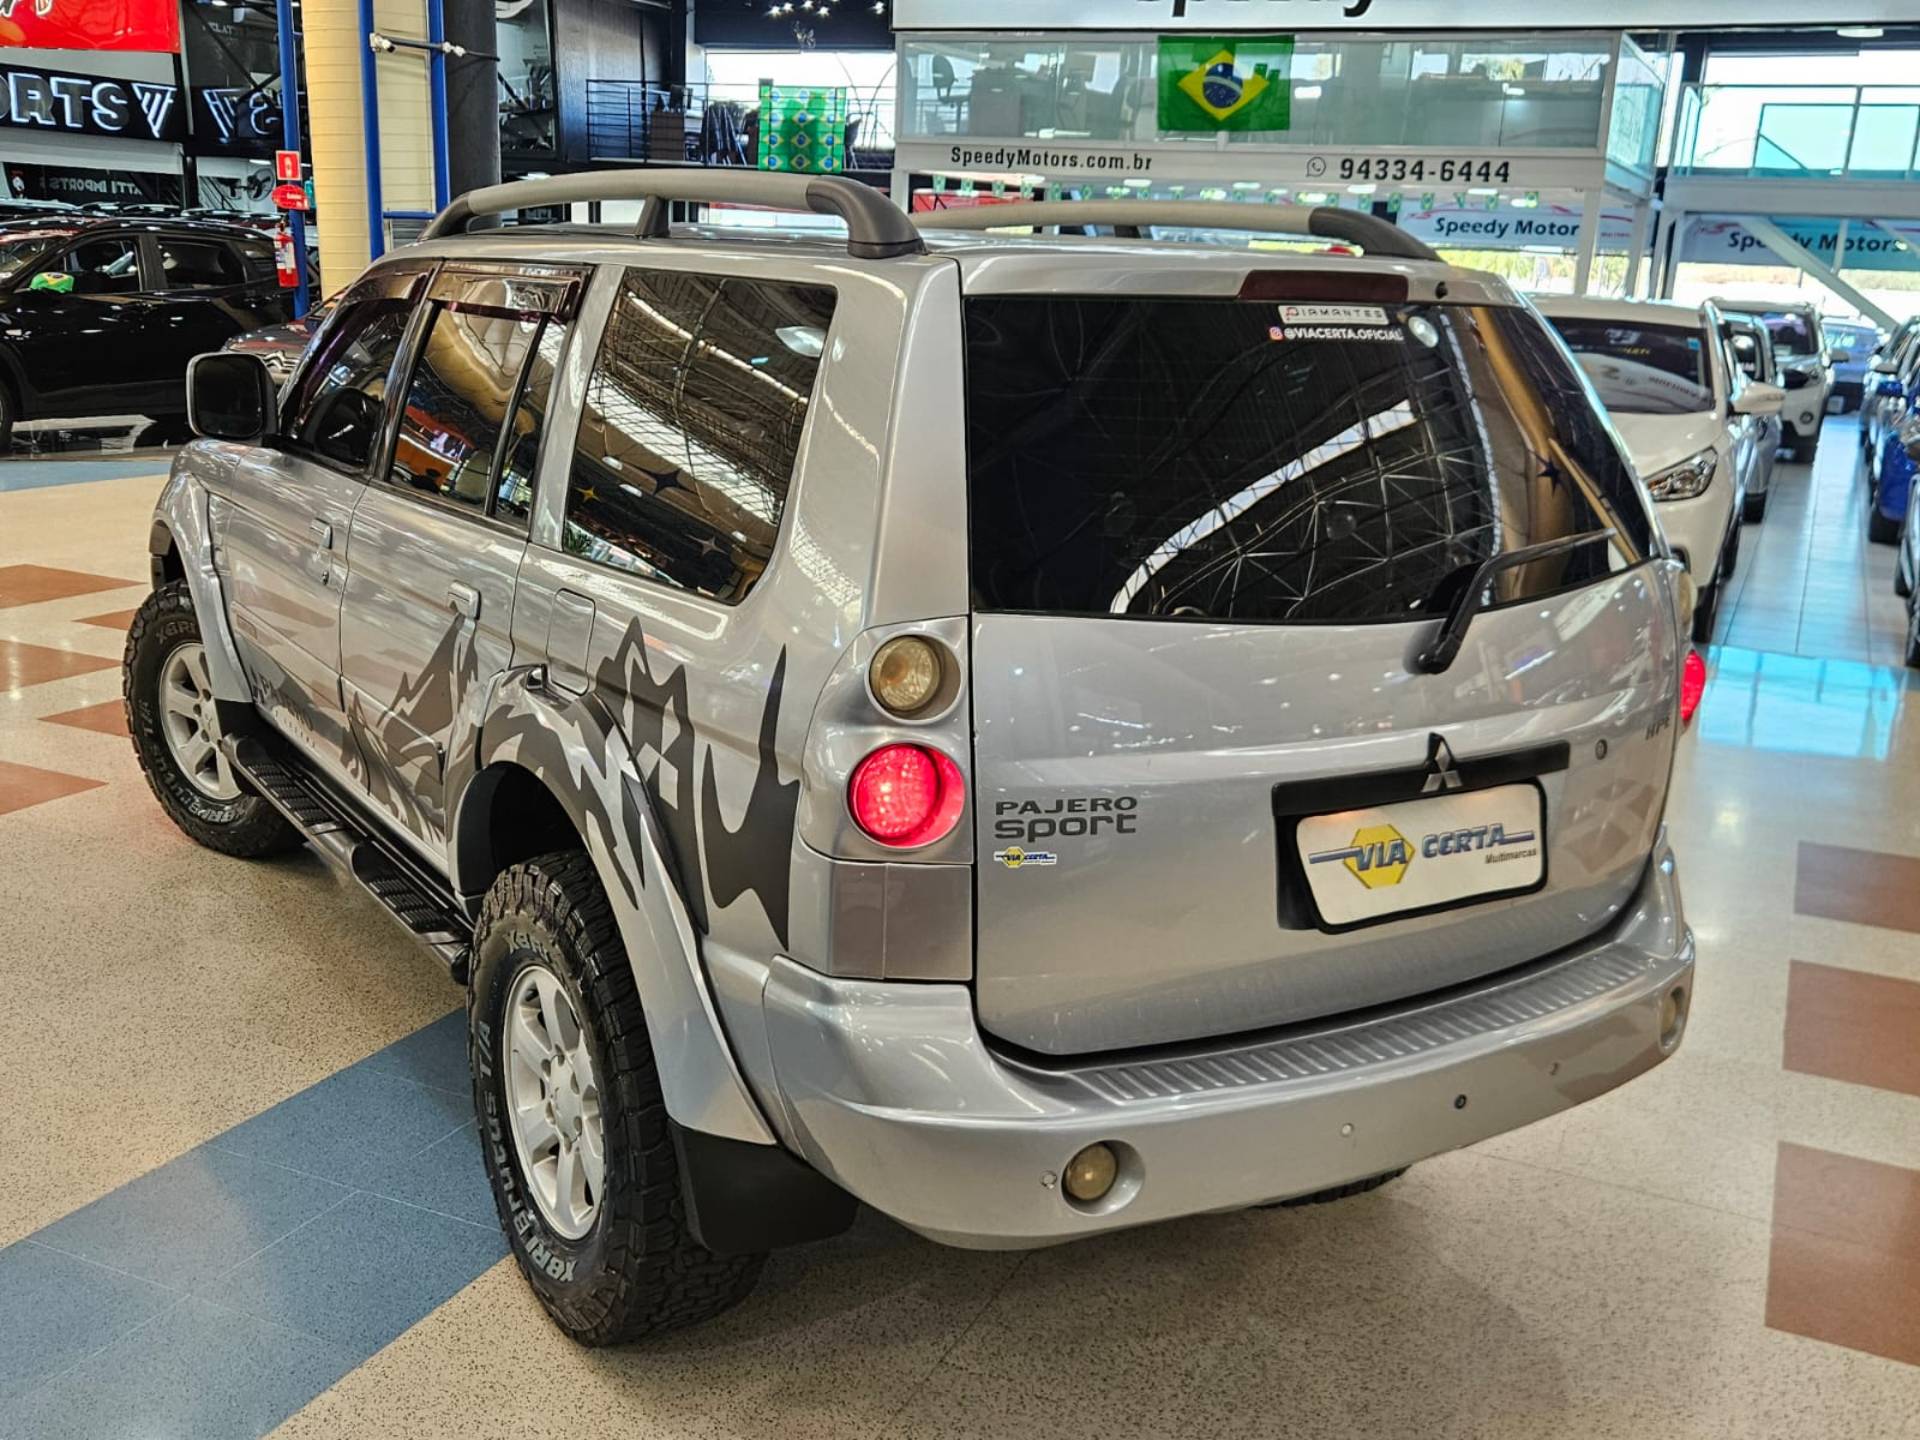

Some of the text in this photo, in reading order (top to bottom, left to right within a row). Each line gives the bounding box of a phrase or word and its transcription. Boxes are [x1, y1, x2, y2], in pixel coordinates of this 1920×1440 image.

[0, 71, 130, 131] RTS
[950, 146, 1153, 170] SpeedyMotors.com.br
[1339, 158, 1511, 183] 94334-6444
[1434, 217, 1509, 238] Speedy
[1514, 220, 1580, 237] Motor
[995, 797, 1138, 815] PAJERO
[1355, 823, 1506, 871] VIA CERTA
